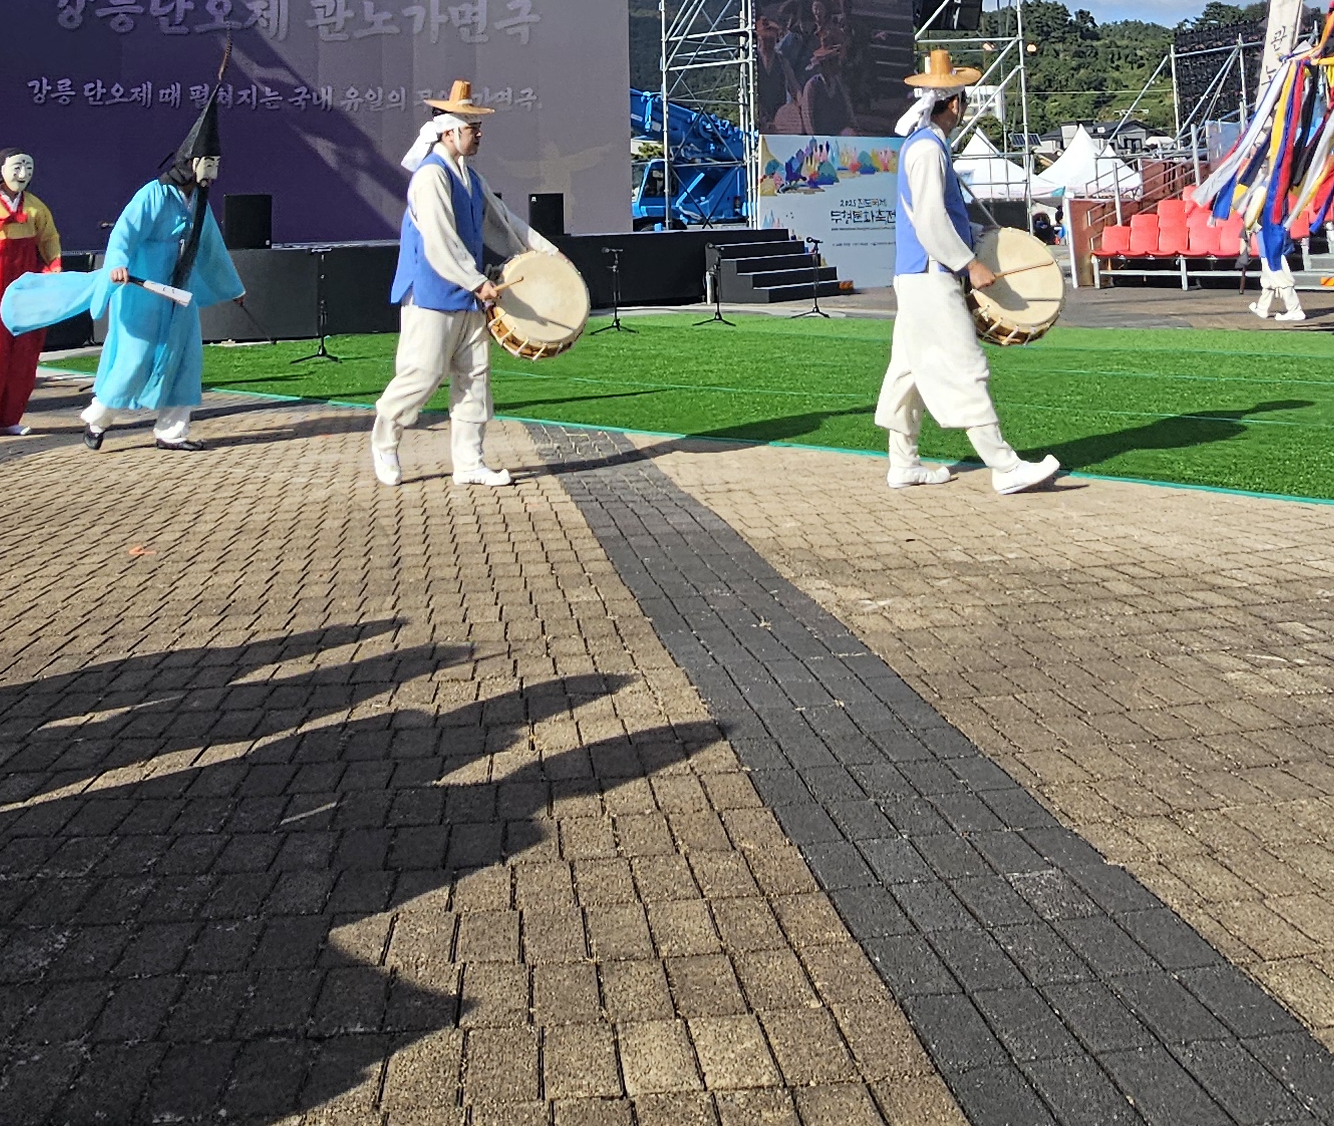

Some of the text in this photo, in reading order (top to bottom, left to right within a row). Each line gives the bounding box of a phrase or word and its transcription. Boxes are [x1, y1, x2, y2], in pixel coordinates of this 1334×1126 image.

[27, 77, 76, 105] 강릉
[83, 79, 152, 108] 단오제
[158, 82, 183, 109] 때
[189, 83, 283, 110] 펼쳐지는
[288, 86, 334, 112] 국내
[339, 86, 408, 112] 유일의
